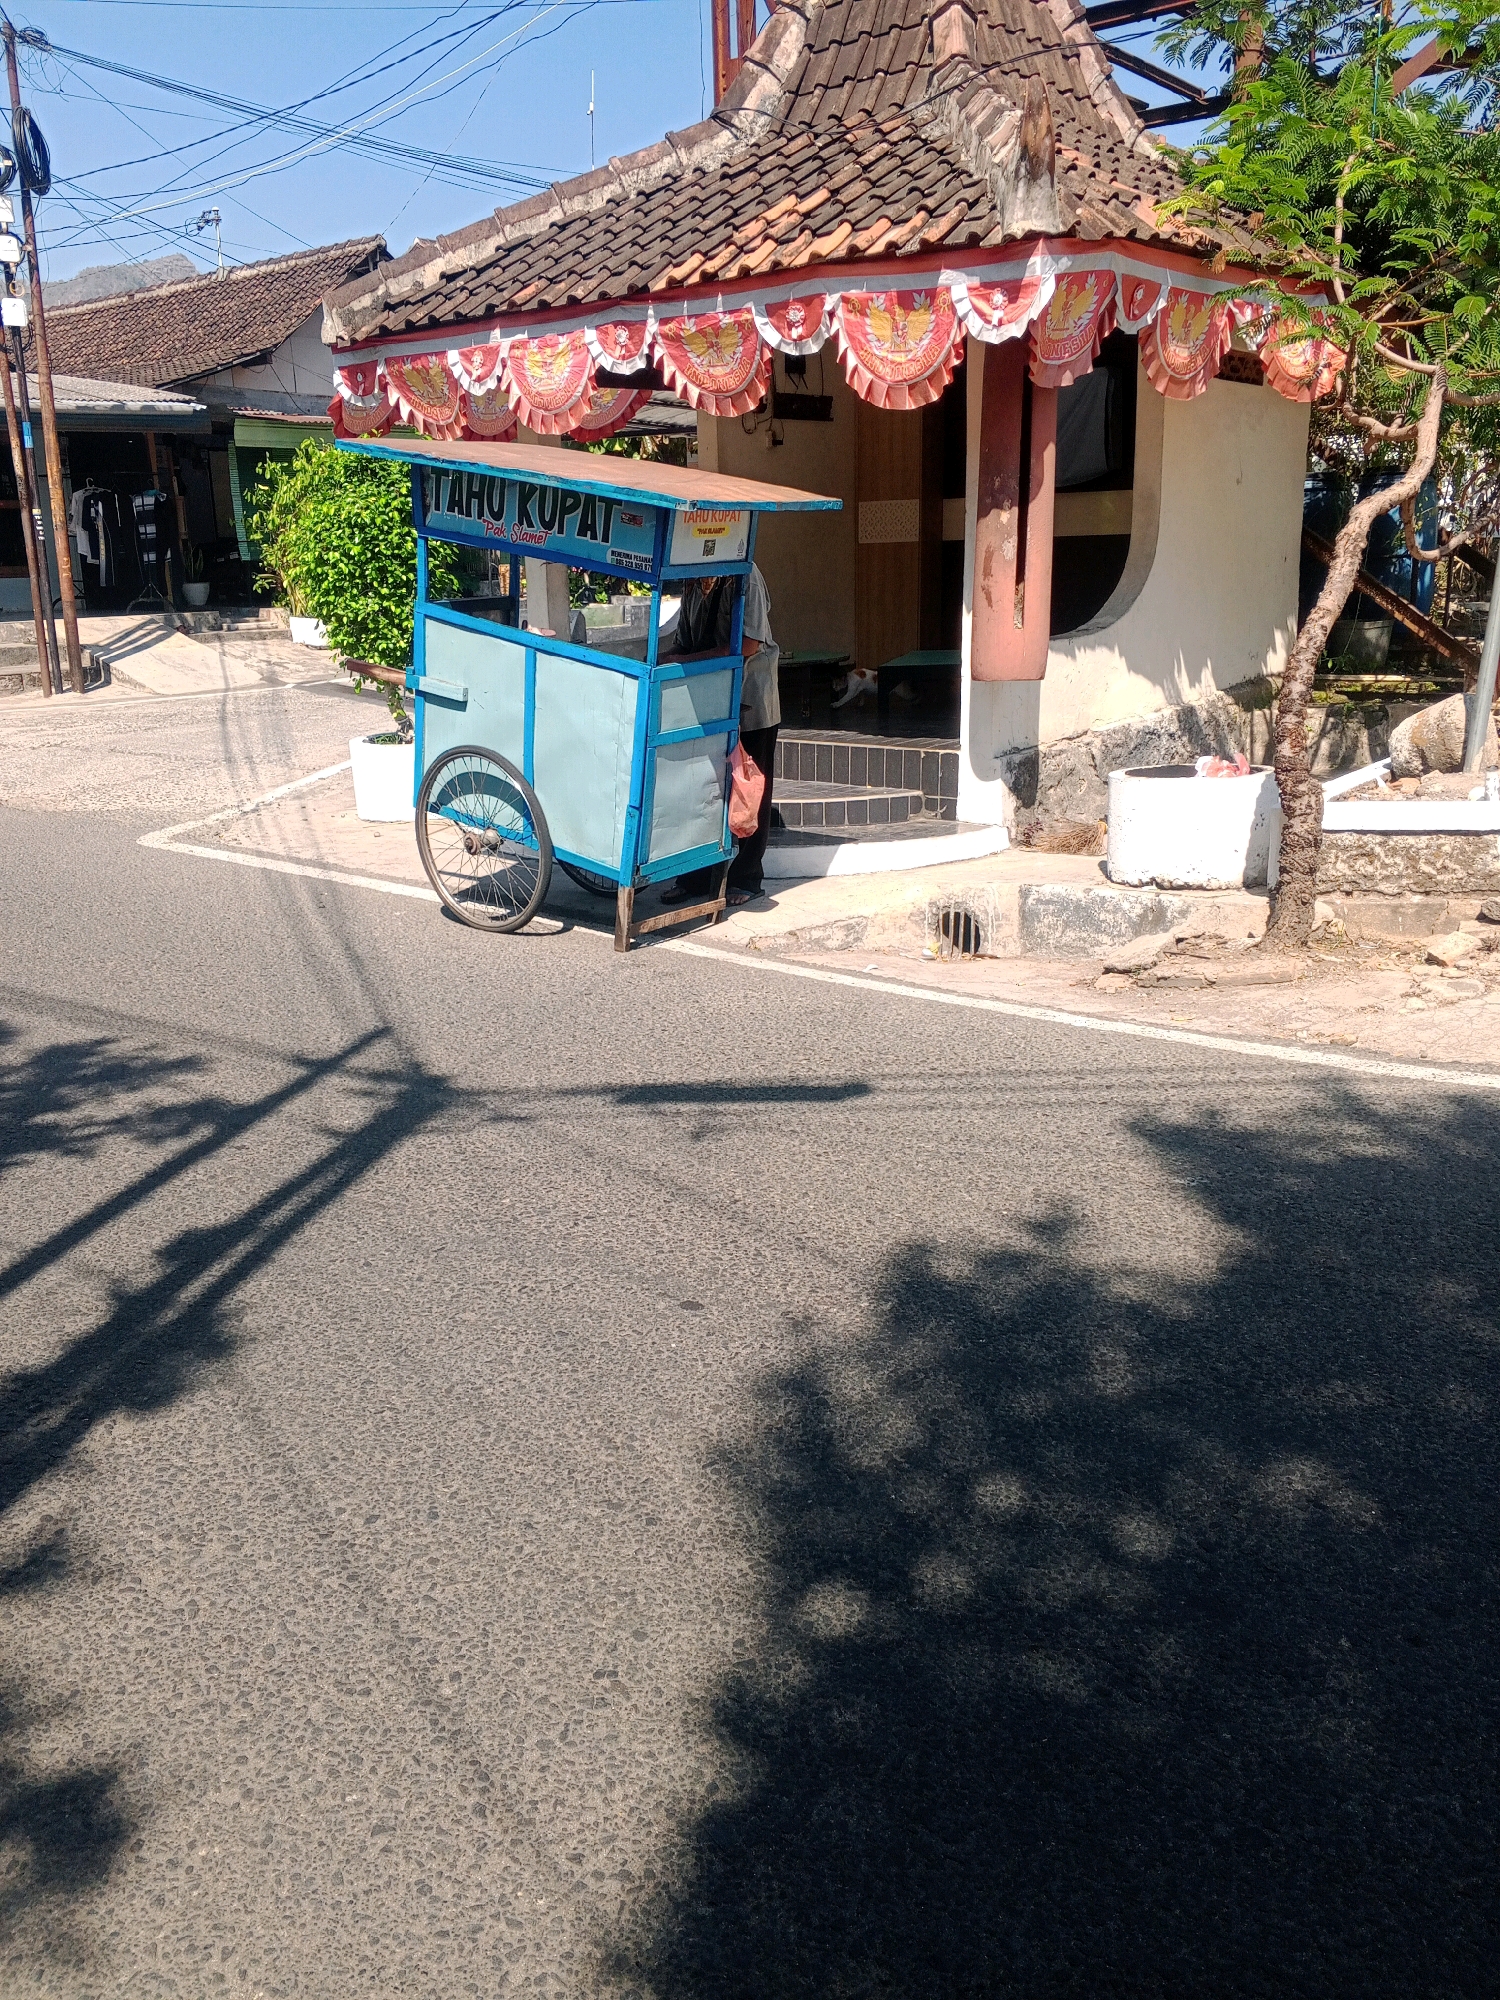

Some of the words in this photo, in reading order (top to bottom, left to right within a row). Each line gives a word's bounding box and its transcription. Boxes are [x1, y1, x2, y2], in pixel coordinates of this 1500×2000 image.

[684, 356, 752, 392] INDONESIA
[860, 343, 941, 380] INDONESIA
[430, 466, 507, 522] TAHU
[517, 481, 623, 544] KUPAT
[683, 510, 709, 524] TAHU
[711, 510, 741, 523] KUPAT
[482, 518, 507, 538] Pak
[610, 549, 633, 561] MENERIMA
